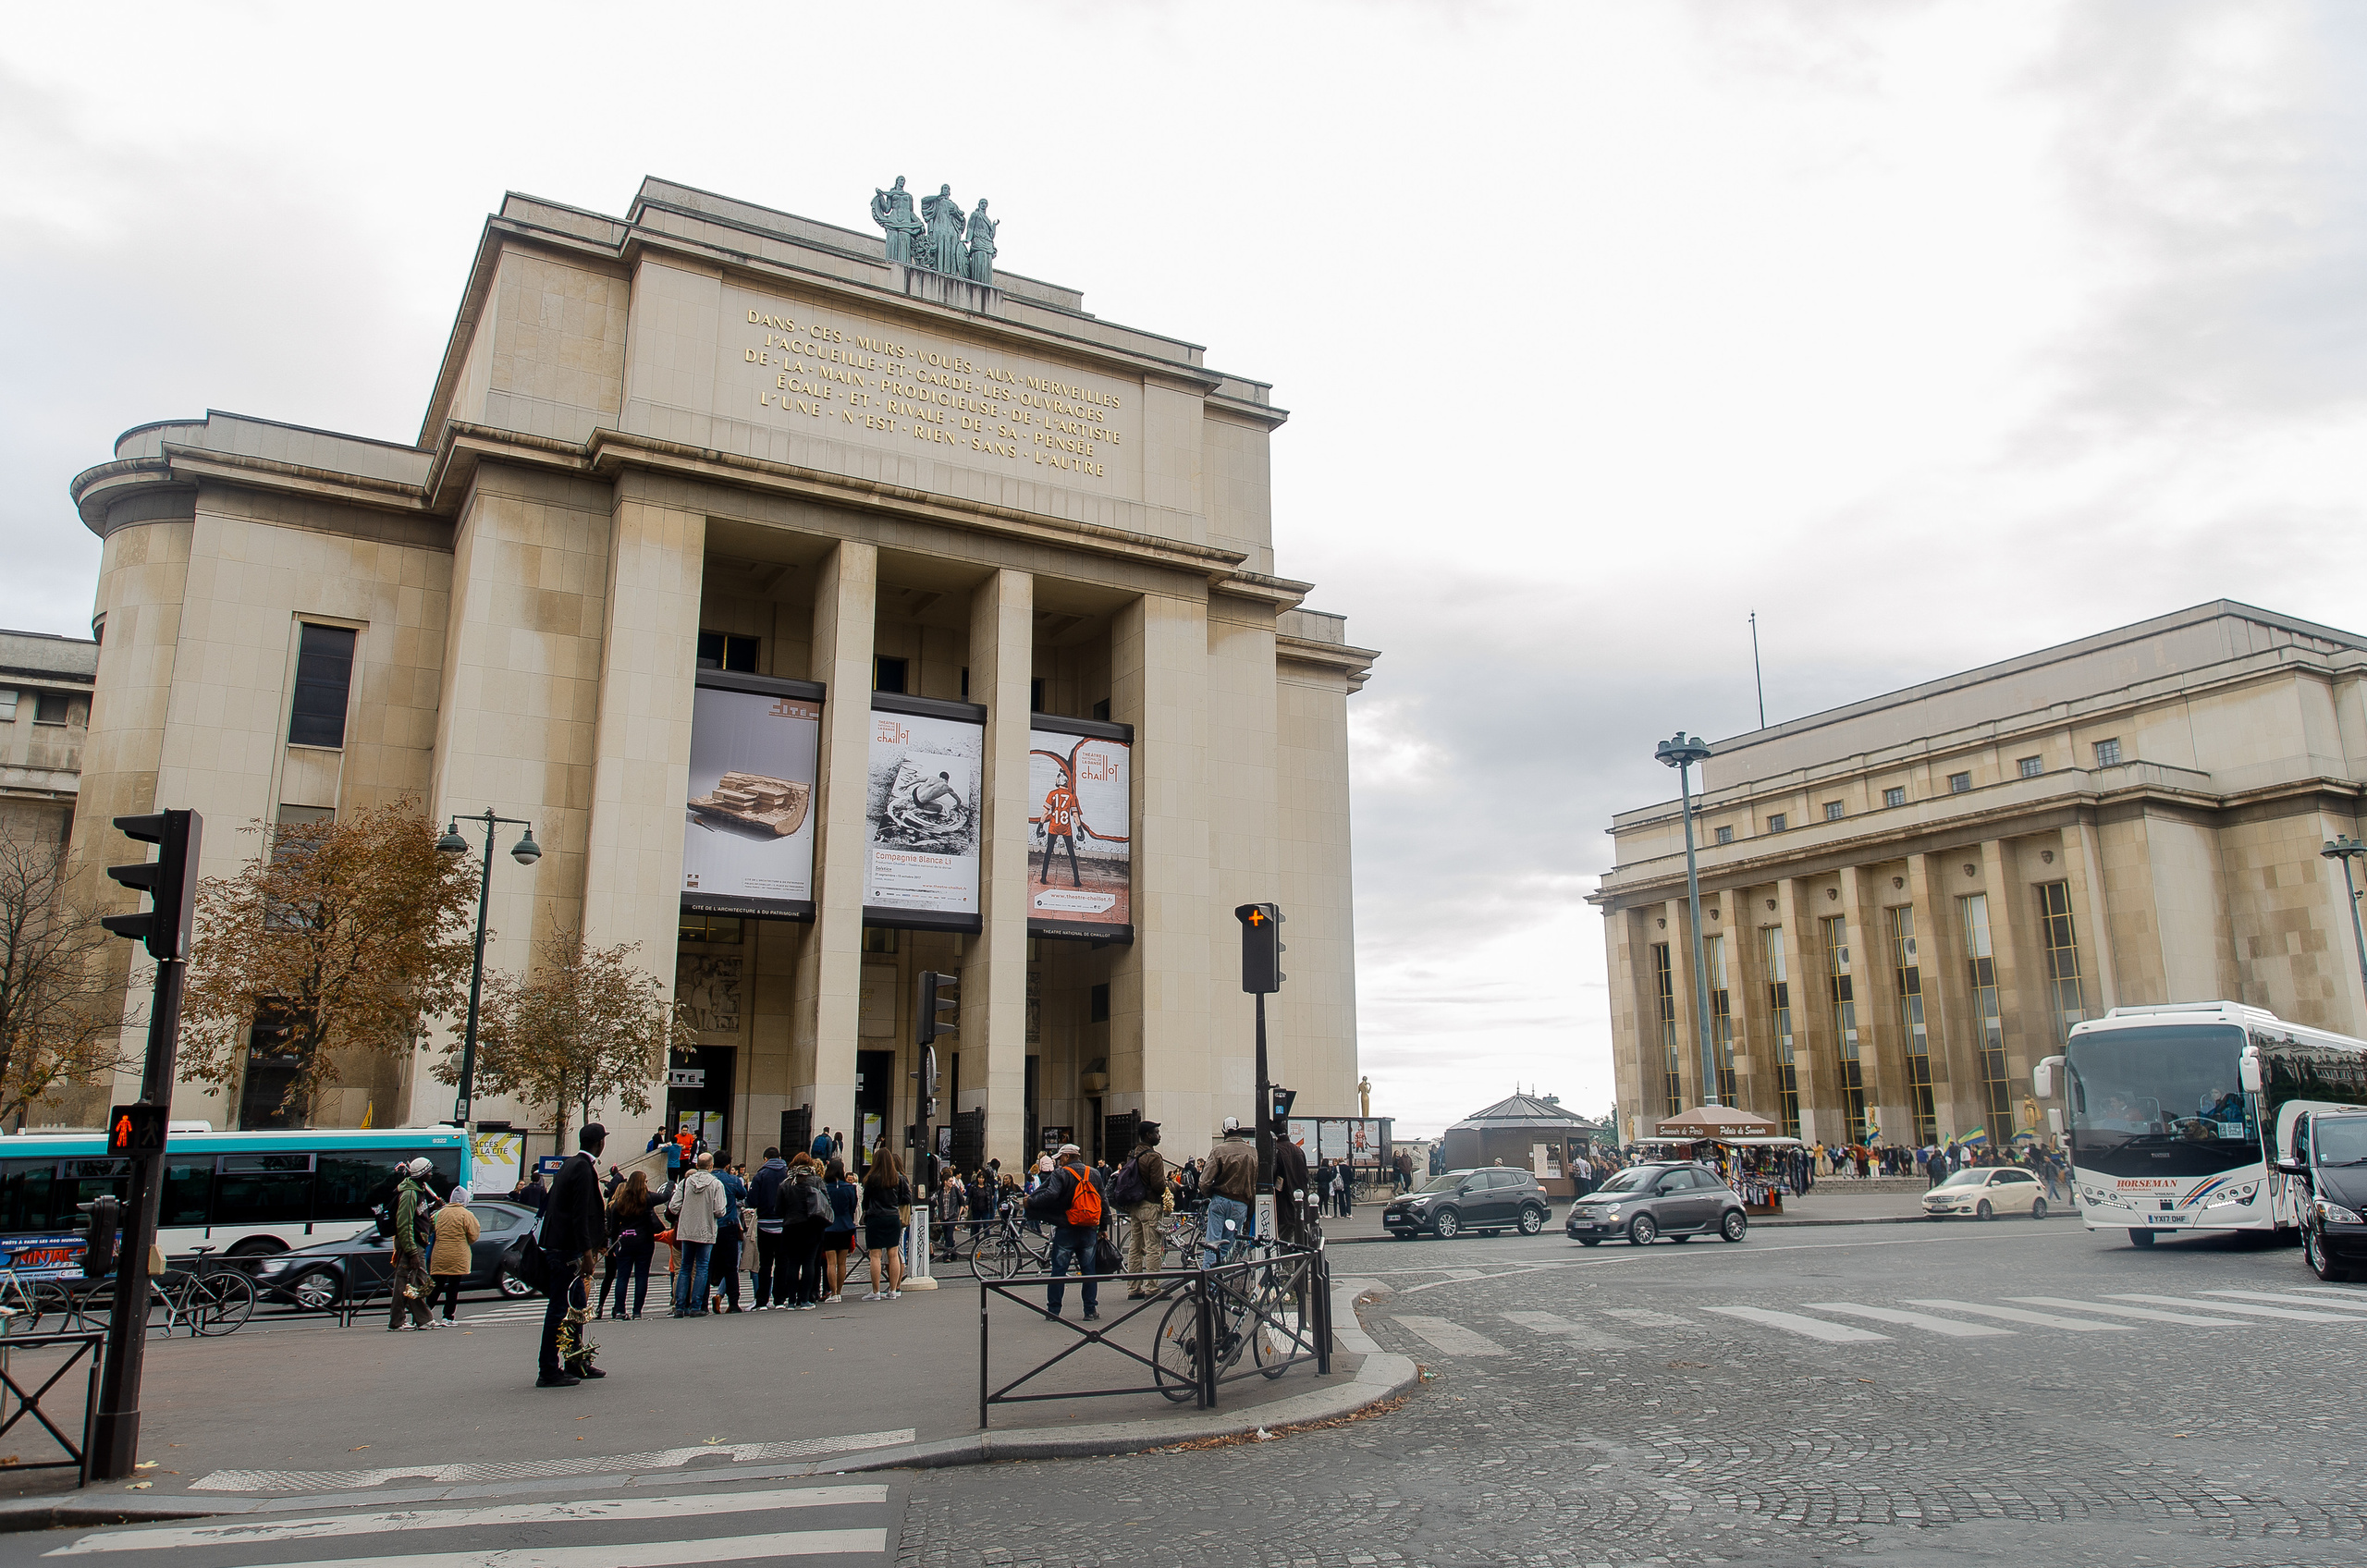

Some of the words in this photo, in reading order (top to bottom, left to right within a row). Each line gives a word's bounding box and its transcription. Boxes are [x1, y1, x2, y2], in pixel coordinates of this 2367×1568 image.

[748, 310, 795, 332] DANS
[810, 325, 842, 343] CES
[855, 336, 906, 358] MURS
[917, 349, 972, 374] VOUÉS
[985, 367, 1015, 385] AUX
[1026, 375, 1121, 409] MERVEILLES
[765, 334, 876, 371] J'ACCUEILLE
[887, 361, 906, 377] ET
[916, 369, 972, 392] GARDE
[983, 384, 1011, 401] LES
[1020, 393, 1104, 423] OUVRAGES
[745, 349, 768, 365] DE
[784, 358, 803, 374] LA
[819, 365, 865, 387] MAIN
[880, 379, 998, 417] PRODIGIEUSE
[1012, 409, 1031, 424] DE
[1045, 416, 1121, 444] L'ARTISTE
[777, 373, 831, 399] ÉGALE
[850, 391, 870, 407] ET
[888, 399, 944, 424] RIVALE
[962, 416, 981, 432] DE
[998, 424, 1017, 440] SA
[1034, 432, 1094, 457] PENSÉE
[761, 391, 820, 416] L'UNE
[842, 410, 897, 432] N'EST
[914, 424, 955, 445] RIEN
[972, 437, 1016, 458] SANS
[1036, 450, 1104, 476] L'AUTRE
[1052, 793, 1070, 808] 17
[1052, 809, 1069, 825] 18
[876, 851, 917, 863] Compagnie
[919, 855, 943, 864] Blanca
[1051, 894, 1113, 902] www.theatre-chaillot.fr
[1681, 1127, 1687, 1135] de
[1689, 1126, 1704, 1135] Paris
[1719, 1126, 1737, 1135] Palais
[1738, 1127, 1744, 1135] de
[492, 1145, 508, 1154] CITÉ
[2116, 1179, 2178, 1188] HORSEMAN
